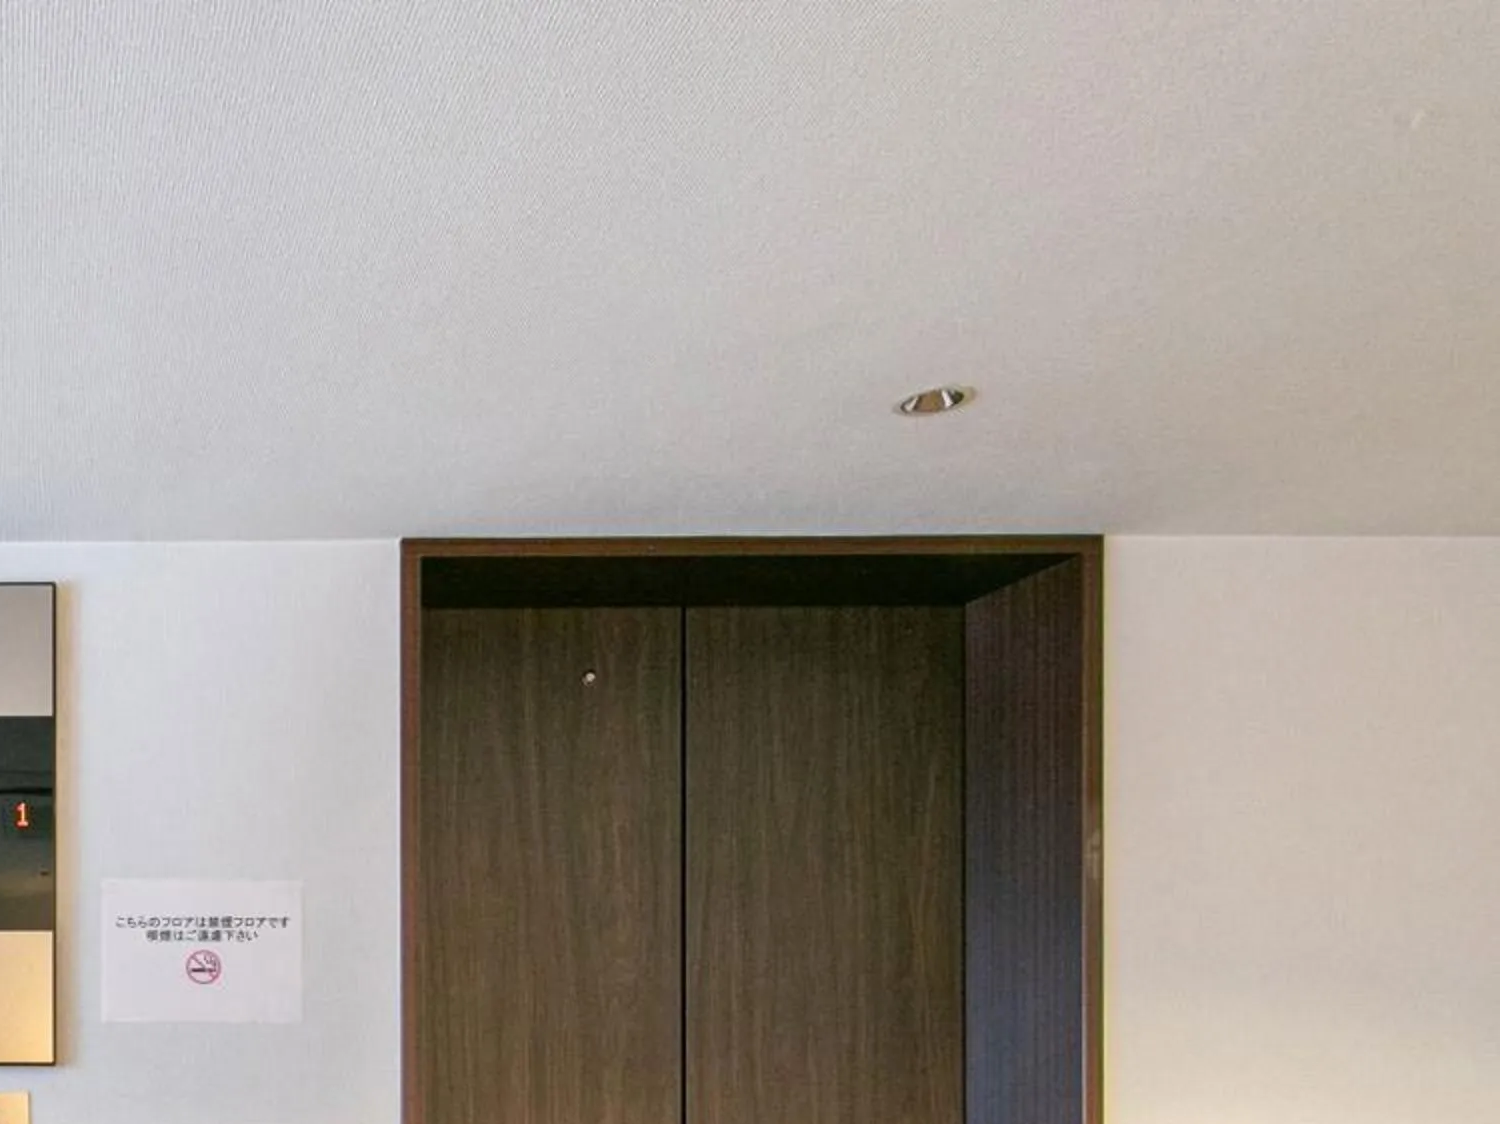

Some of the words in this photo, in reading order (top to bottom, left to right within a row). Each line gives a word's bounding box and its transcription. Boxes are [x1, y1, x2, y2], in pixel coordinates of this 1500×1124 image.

[15, 802, 30, 827] 1
[115, 916, 291, 928] こちらのフロアは禁煙フロアです
[146, 930, 259, 942] 喫煙はご遠慮下さい
